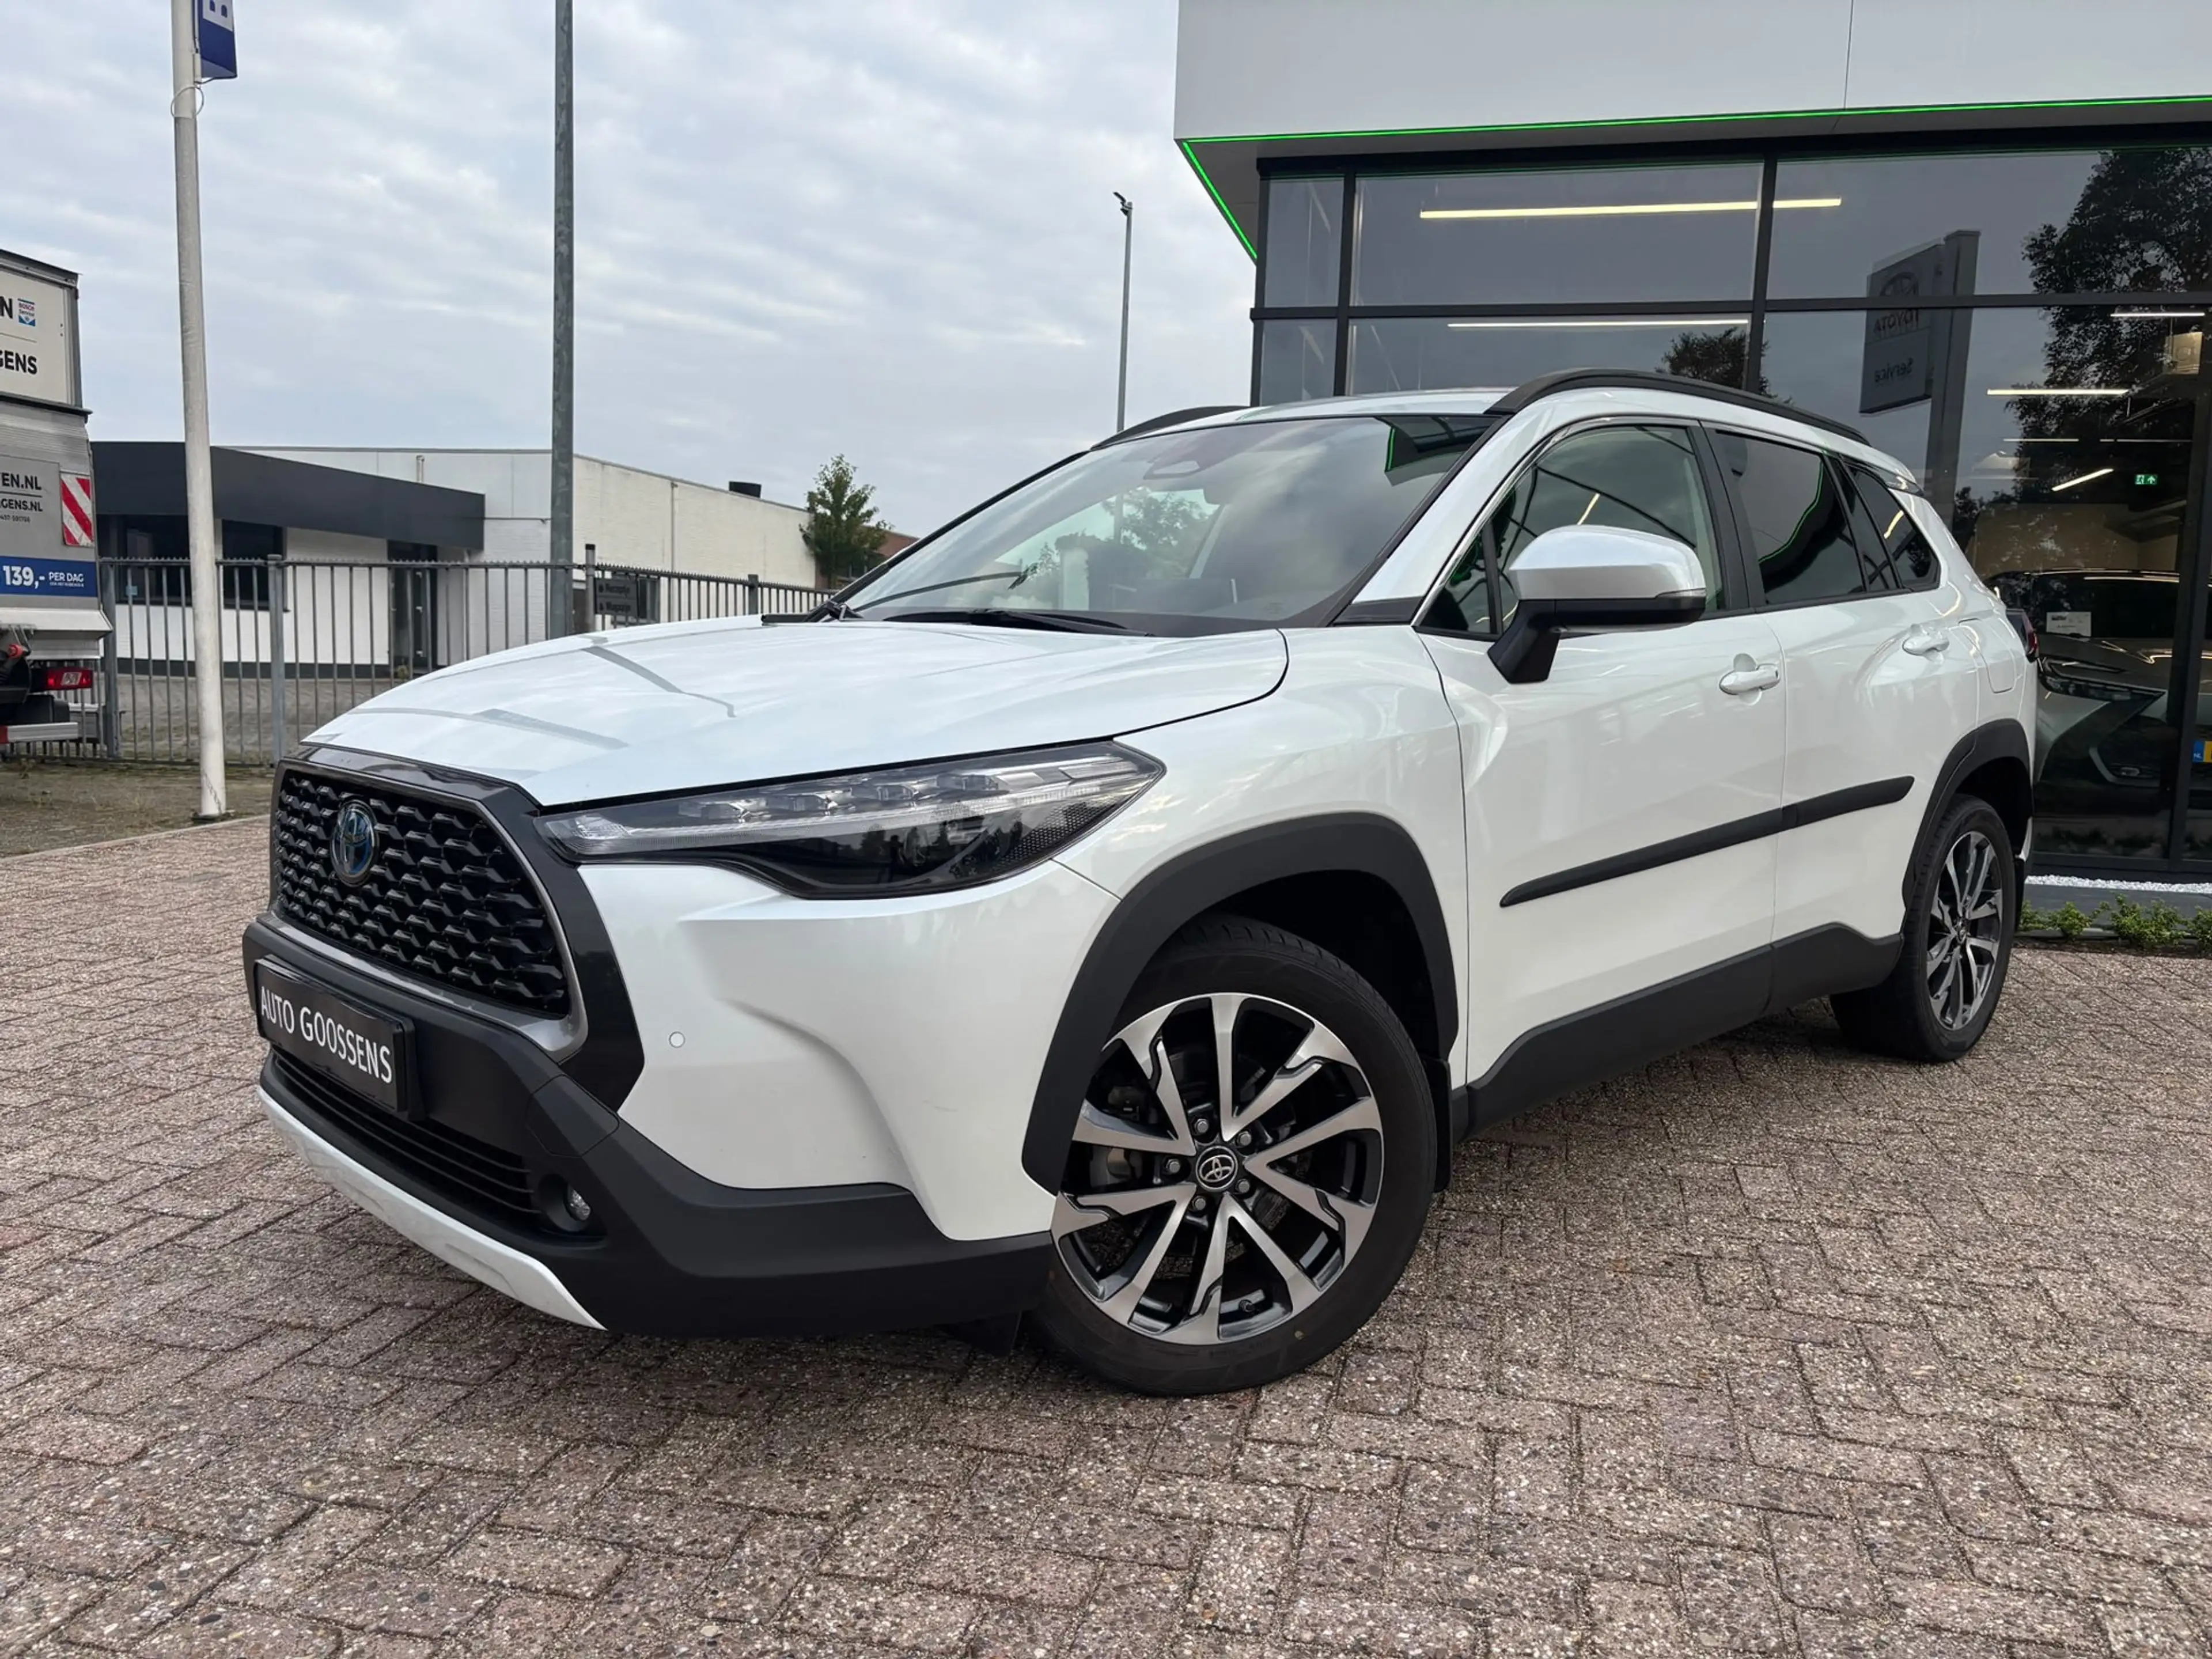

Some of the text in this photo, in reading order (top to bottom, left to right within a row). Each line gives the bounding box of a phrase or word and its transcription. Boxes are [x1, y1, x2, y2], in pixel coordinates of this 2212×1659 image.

[2, 566, 46, 589] 139,-
[48, 571, 65, 581] PER
[67, 573, 84, 582] DAG
[261, 986, 392, 1084] AUTO GOOSSENS
